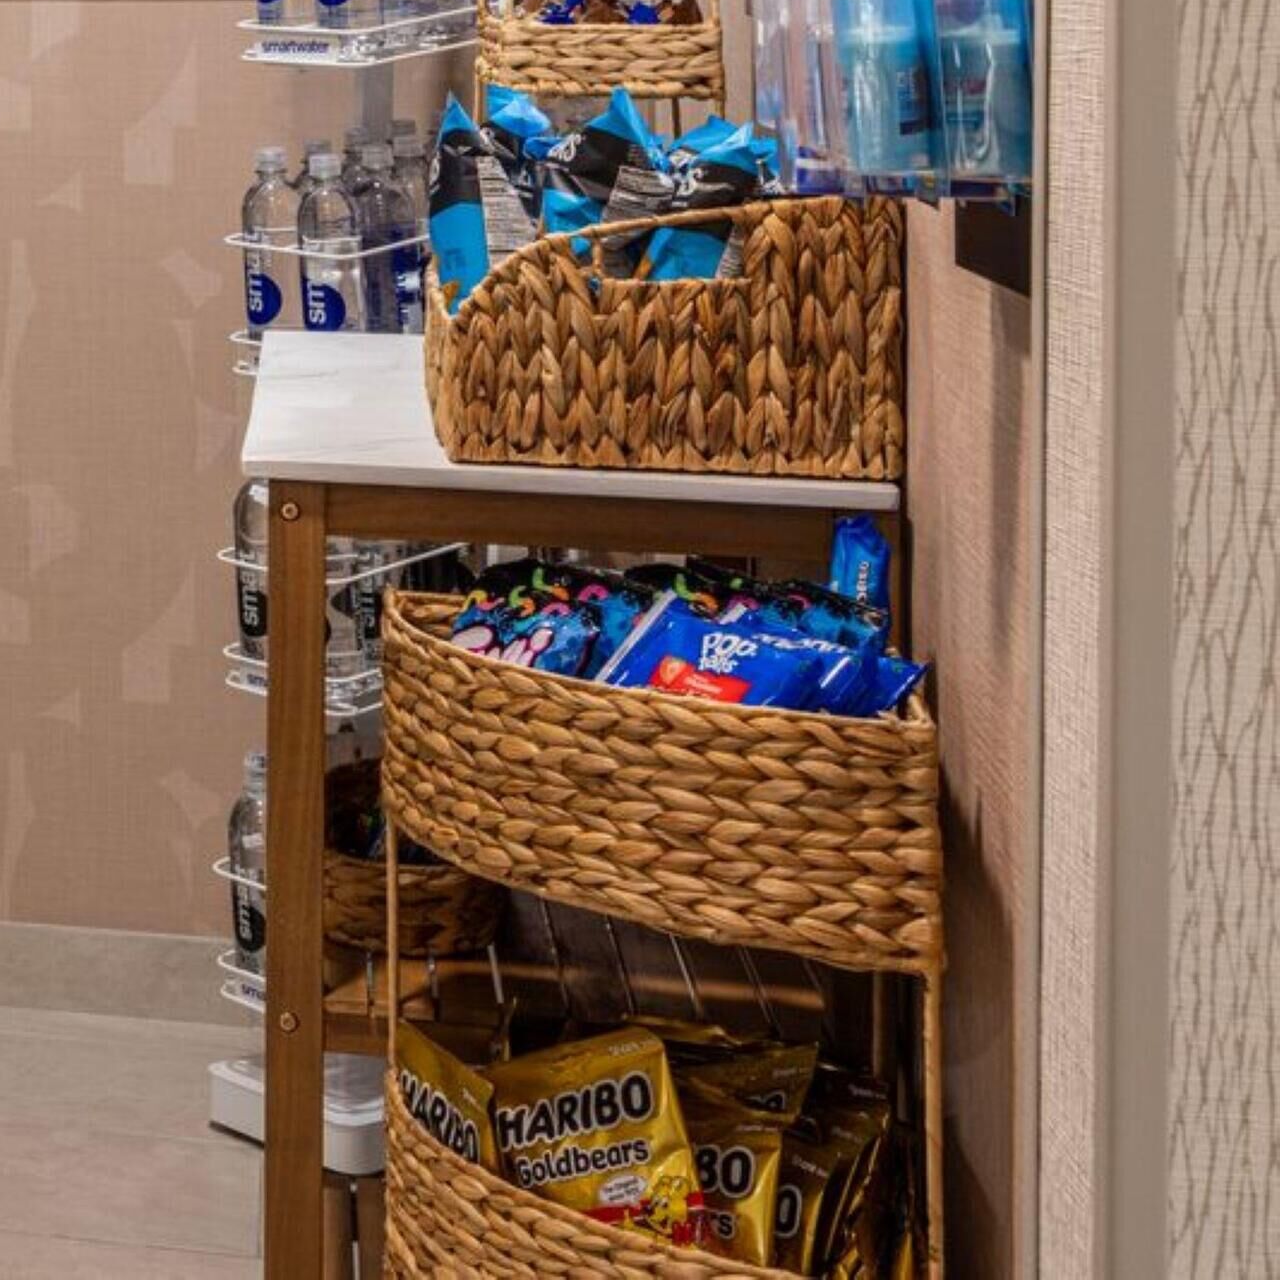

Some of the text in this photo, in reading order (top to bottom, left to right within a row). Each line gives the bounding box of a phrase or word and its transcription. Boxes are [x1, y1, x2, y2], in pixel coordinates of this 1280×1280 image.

[261, 39, 331, 54] smartwater
[497, 1071, 653, 1151] HARIBO
[516, 1139, 650, 1188] Goldbears
